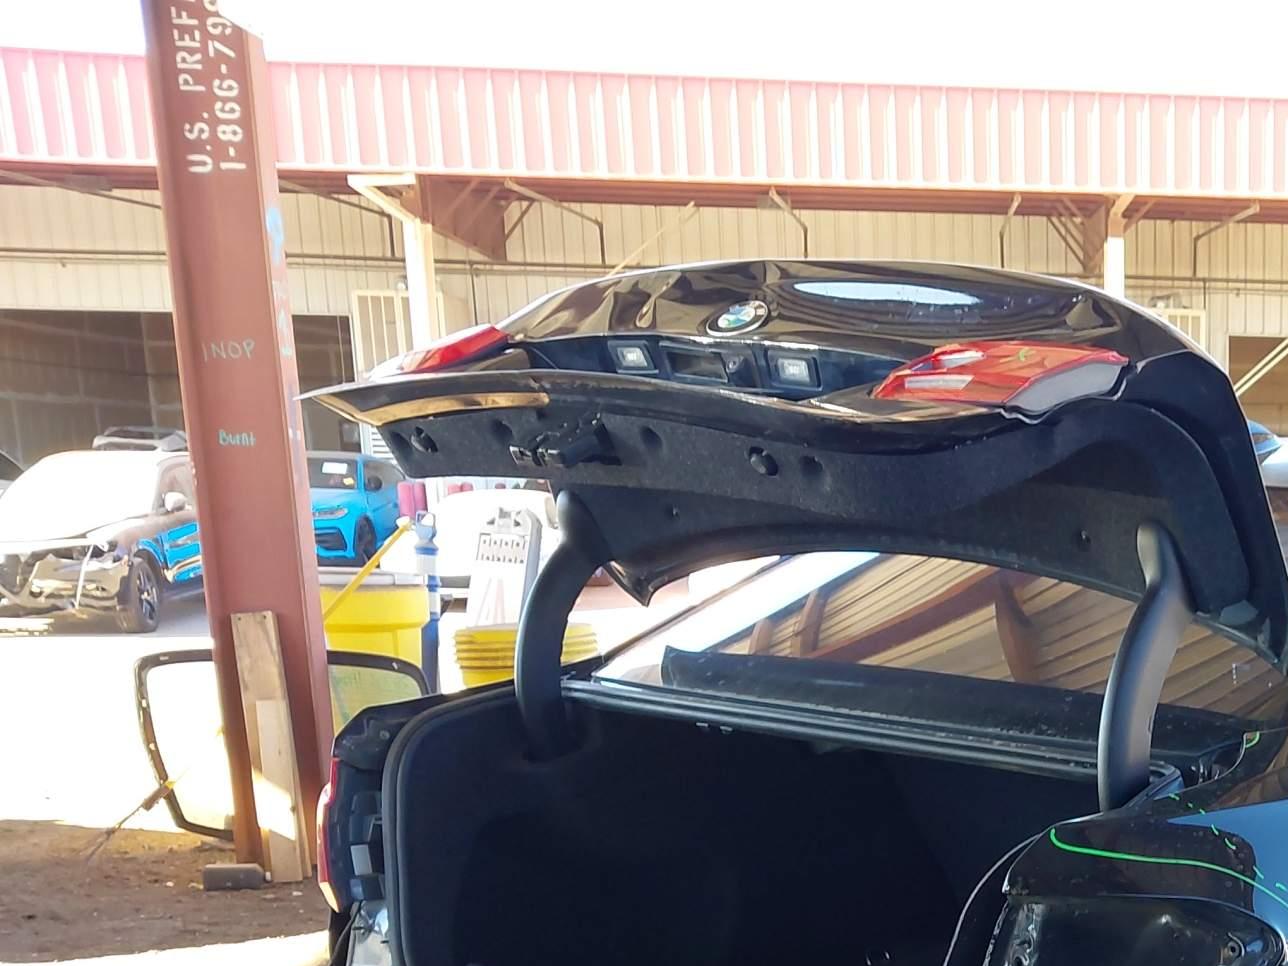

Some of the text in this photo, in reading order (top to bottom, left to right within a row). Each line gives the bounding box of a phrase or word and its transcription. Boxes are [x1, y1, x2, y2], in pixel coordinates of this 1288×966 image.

[170, 0, 214, 174] U.S. PREF
[201, 338, 256, 363] INOP
